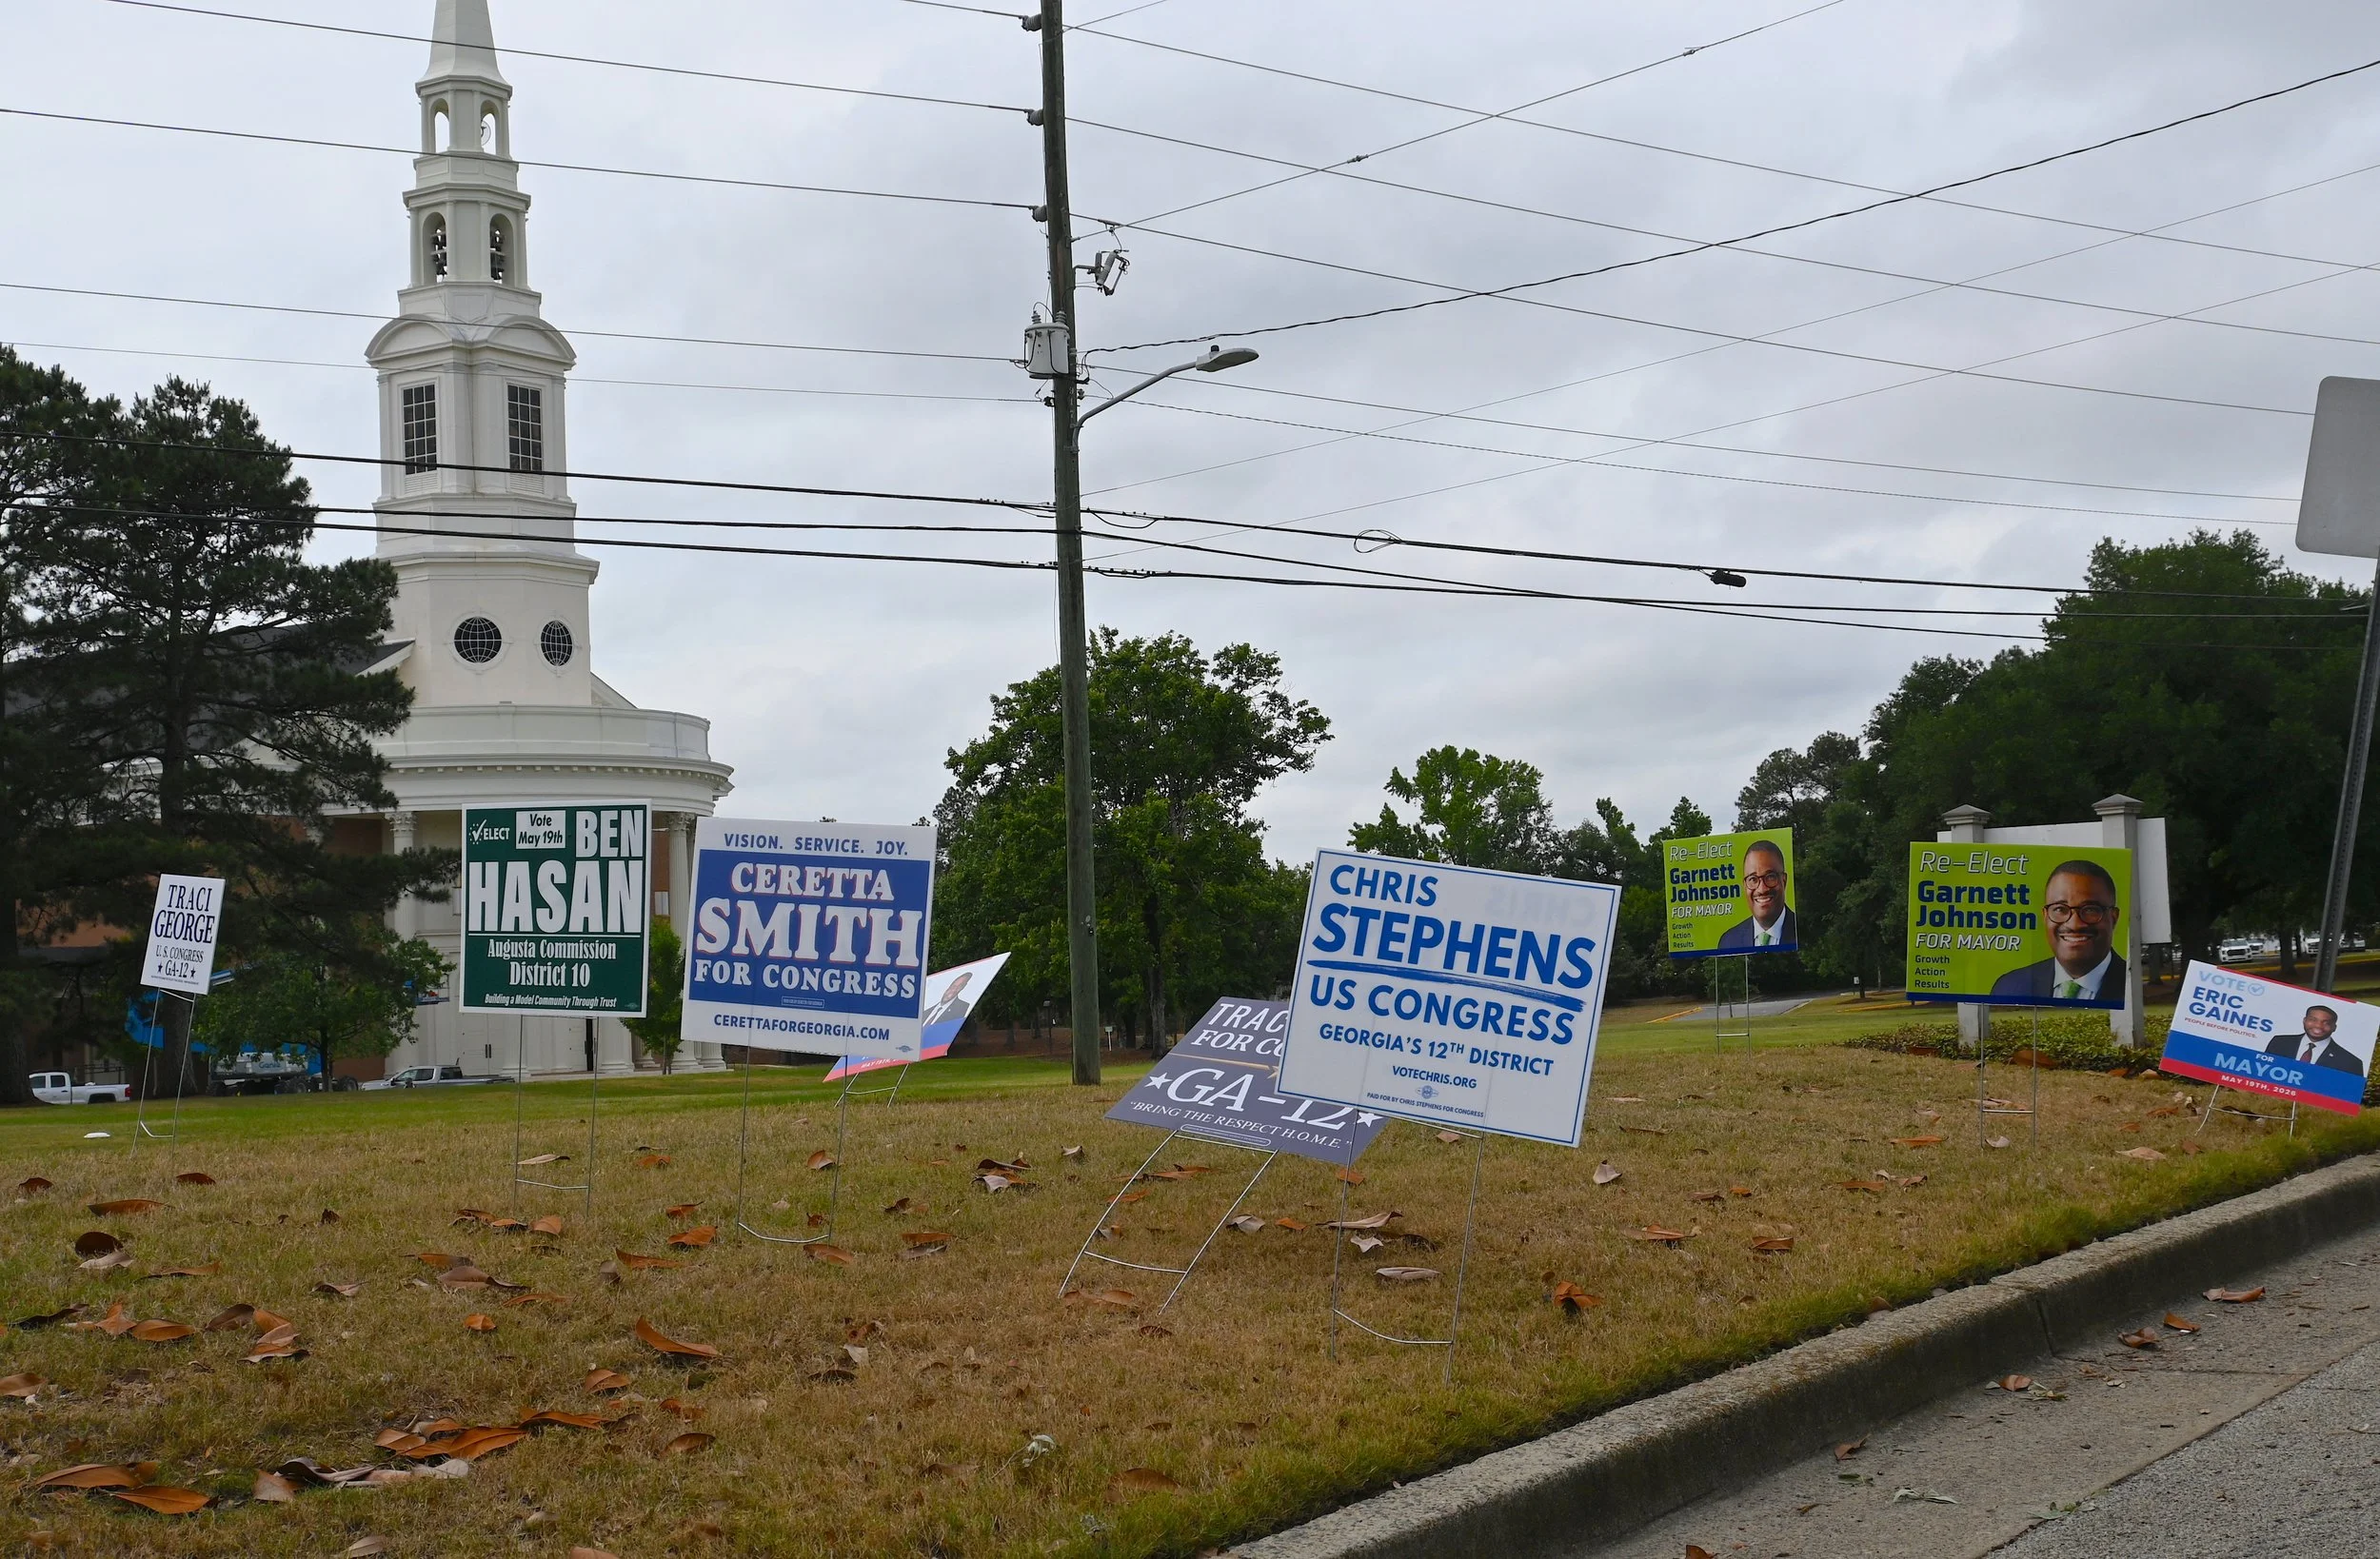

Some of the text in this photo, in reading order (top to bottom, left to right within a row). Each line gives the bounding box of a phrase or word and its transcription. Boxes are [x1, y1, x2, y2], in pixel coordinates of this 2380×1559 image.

[529, 814, 552, 826] Vote
[484, 828, 509, 840] ELECT
[518, 830, 563, 847] May 19th
[576, 810, 644, 858] BEN
[724, 834, 908, 856] VISION. SERVICE. JOY.
[1670, 841, 1733, 861] Re-Elect
[1670, 863, 1735, 884] Garnett
[1920, 851, 2029, 875] Re-Elect
[731, 862, 894, 900] CERETTA
[1330, 864, 1438, 907] CHRIS
[168, 885, 212, 912] TRACI
[468, 860, 644, 933] HASAN
[1671, 884, 1740, 903] Johnson
[1917, 880, 2030, 905] Garnett
[1672, 903, 1733, 918] FOR MAYOR
[1916, 905, 2036, 930] Johnson
[154, 910, 215, 943] GEORGE
[697, 898, 922, 967] SMITH
[487, 938, 616, 959] Augusta Commission
[1312, 903, 1596, 990] STEPHENS
[1915, 934, 2020, 951] FOR MAYOR
[169, 947, 204, 963] CONGRESS
[1915, 955, 1950, 964] Growth
[166, 959, 188, 977] GA-12
[509, 961, 590, 987] District 10
[694, 959, 916, 999] FOR CONGRESS
[1915, 968, 1946, 977] Action
[1915, 980, 1950, 989] Results
[2199, 971, 2247, 991] VOTE
[485, 994, 509, 1006] Building
[515, 995, 534, 1004] Model
[535, 996, 571, 1008] Community
[571, 997, 599, 1009] Through
[600, 997, 617, 1007] Trust
[2192, 986, 2244, 1009] ERIC
[1310, 975, 1575, 1045] US CONGRESS
[2189, 1002, 2273, 1032] GAINES
[714, 1015, 890, 1041] CERETTAFORGEORGIA.COM
[2185, 1017, 2205, 1026] PEOPLE
[2207, 1022, 2228, 1031] BEFORE
[1191, 1030, 1253, 1052] FOR
[1319, 1023, 1554, 1076] GEORGIA’S 12TH DISTRICT
[2214, 1053, 2304, 1085] MAYOR
[2256, 1054, 2274, 1062] FOR
[1393, 1066, 1477, 1089] VOTECHRIS.ORG
[2221, 1076, 2243, 1084] MAY
[2273, 1087, 2296, 1096] 2026
[1130, 1101, 1181, 1118] “BRING
[1183, 1111, 1213, 1124] THE
[1214, 1115, 1281, 1135] RESPECT
[1417, 1100, 1441, 1110] STEPHENS
[1455, 1108, 1483, 1117] CONGRESS
